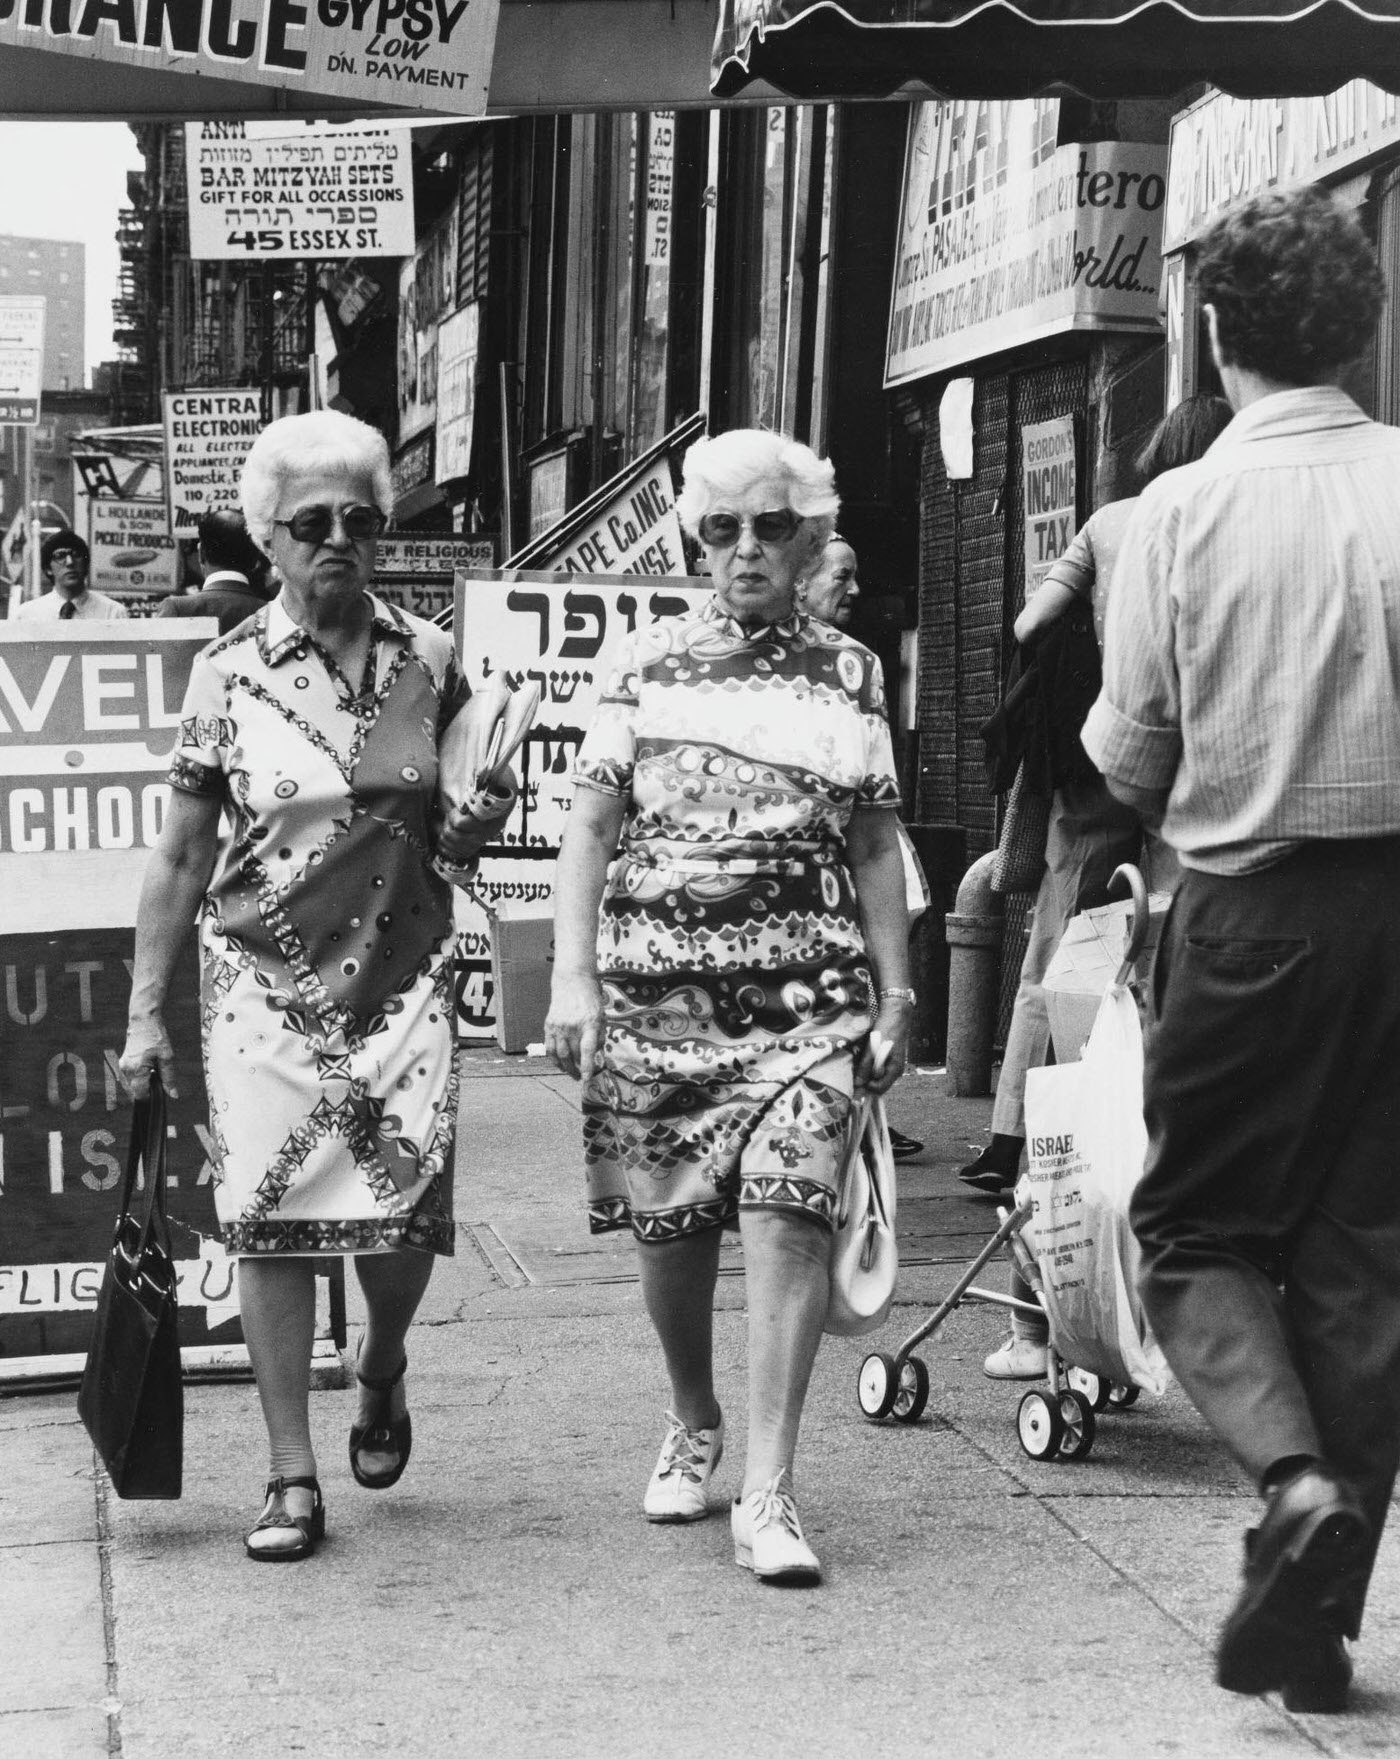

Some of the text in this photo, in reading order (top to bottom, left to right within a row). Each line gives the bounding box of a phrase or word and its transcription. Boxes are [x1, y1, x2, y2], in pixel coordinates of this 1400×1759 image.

[317, 0, 469, 44] GYPSY
[366, 60, 469, 90] PAYMENT
[201, 167, 246, 187] BAR
[348, 164, 394, 185] SETS
[200, 189, 404, 203] GIFT FOR ALL OCCASSIONS
[225, 206, 377, 226] ספרי תורה
[227, 228, 382, 251] 45 ESSEX ST.
[176, 443, 194, 453] ALL
[185, 490, 203, 501] 110
[214, 490, 239, 500] 220
[1027, 461, 1074, 515] INCOME
[1034, 516, 1069, 561] TAX
[404, 546, 491, 558] RELIGIOUS
